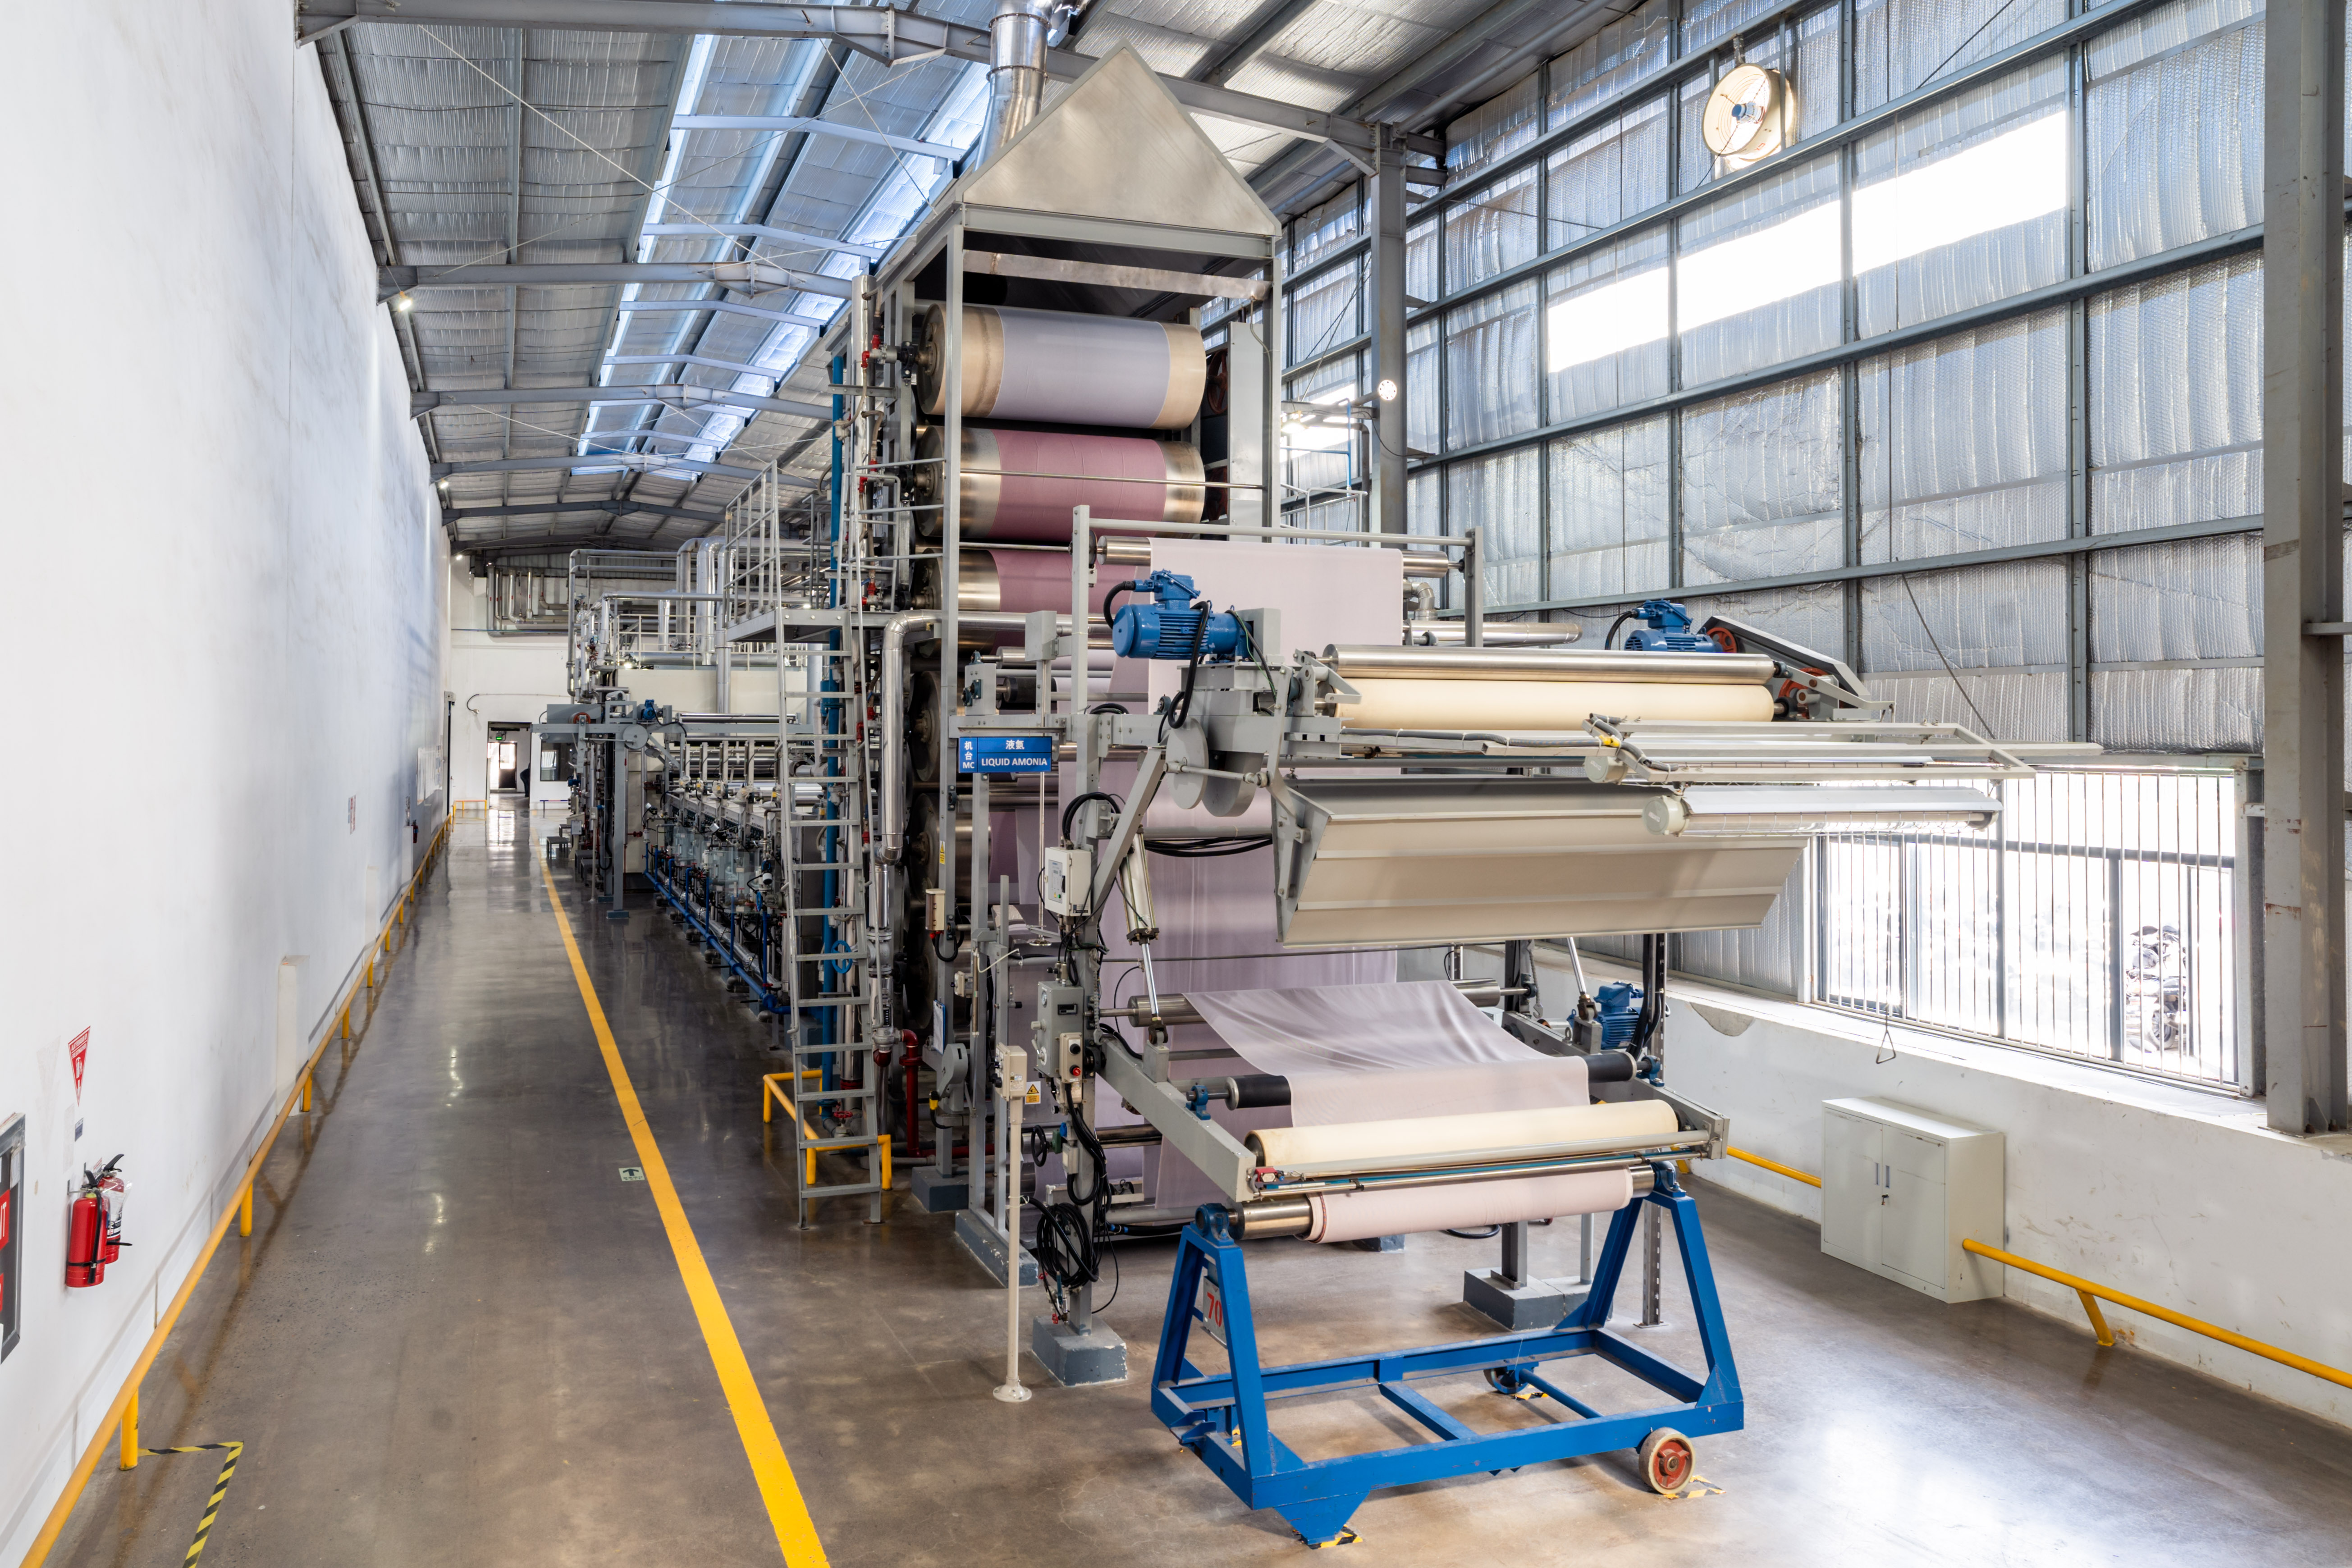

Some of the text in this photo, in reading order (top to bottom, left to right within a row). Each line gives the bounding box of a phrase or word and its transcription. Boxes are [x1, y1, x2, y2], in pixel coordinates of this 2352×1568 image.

[1006, 740, 1025, 750] 液氨
[981, 758, 1010, 767] LIQUID
[1207, 1291, 1222, 1327] 70
